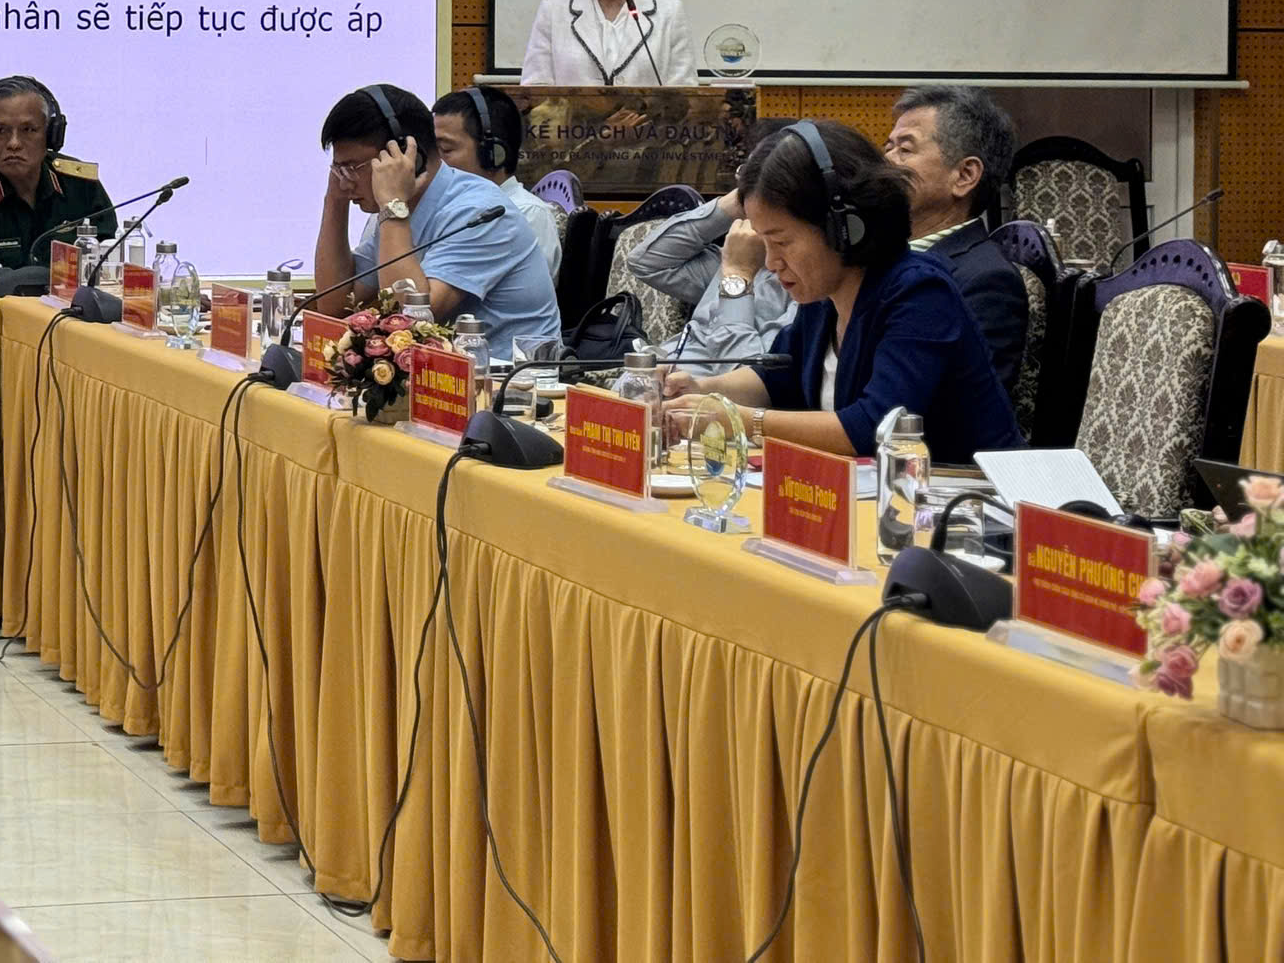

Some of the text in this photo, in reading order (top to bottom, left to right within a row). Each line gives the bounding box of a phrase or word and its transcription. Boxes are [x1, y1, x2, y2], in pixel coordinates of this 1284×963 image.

[583, 421, 601, 443] PHẠM
[784, 475, 814, 504] Virginia
[814, 484, 837, 512] Foote
[1036, 544, 1077, 580] NGUYỄN
[1079, 556, 1124, 595] PHƯƠNG
